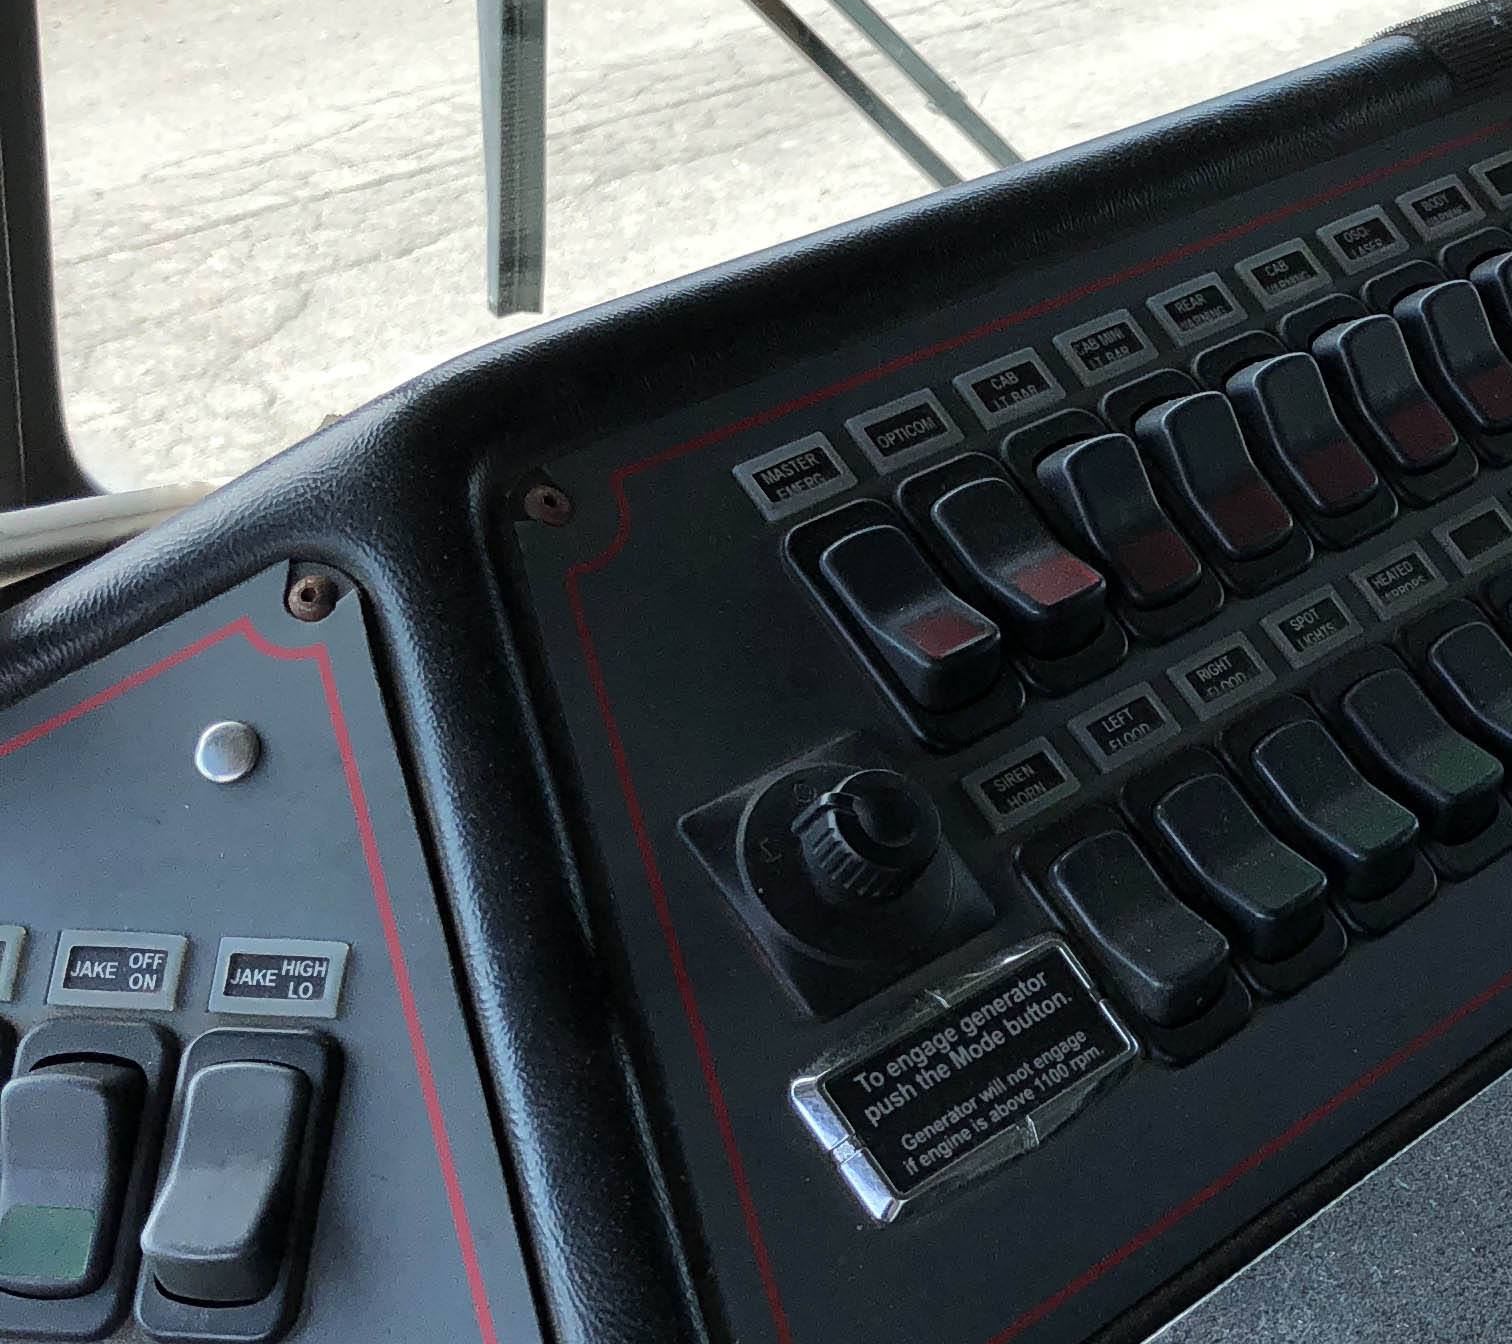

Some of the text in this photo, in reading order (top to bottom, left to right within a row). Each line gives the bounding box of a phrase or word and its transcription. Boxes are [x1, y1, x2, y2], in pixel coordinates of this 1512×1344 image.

[1263, 260, 1291, 278] CAB
[1175, 294, 1208, 314] REAR
[990, 370, 1021, 392] CAB
[876, 415, 937, 451] OPTICOM
[760, 453, 821, 488] MASTER
[1370, 560, 1415, 587] HEATED
[1288, 607, 1323, 632] SPOT
[1195, 656, 1235, 683] RIGHT
[1101, 708, 1136, 734] LEFT
[992, 763, 1038, 792] SIREN
[1009, 781, 1049, 811] HORN
[69, 952, 166, 980] JAKE OFF
[230, 959, 328, 987] JAKE HIGH
[127, 973, 157, 991] ON
[287, 981, 314, 999] LO
[853, 971, 1048, 1094] To engage generator
[864, 991, 1073, 1128] push the Mode button.
[900, 1030, 1088, 1151] Generator will not engage
[902, 1045, 1105, 1176] if engine is above 1100 rpm.
